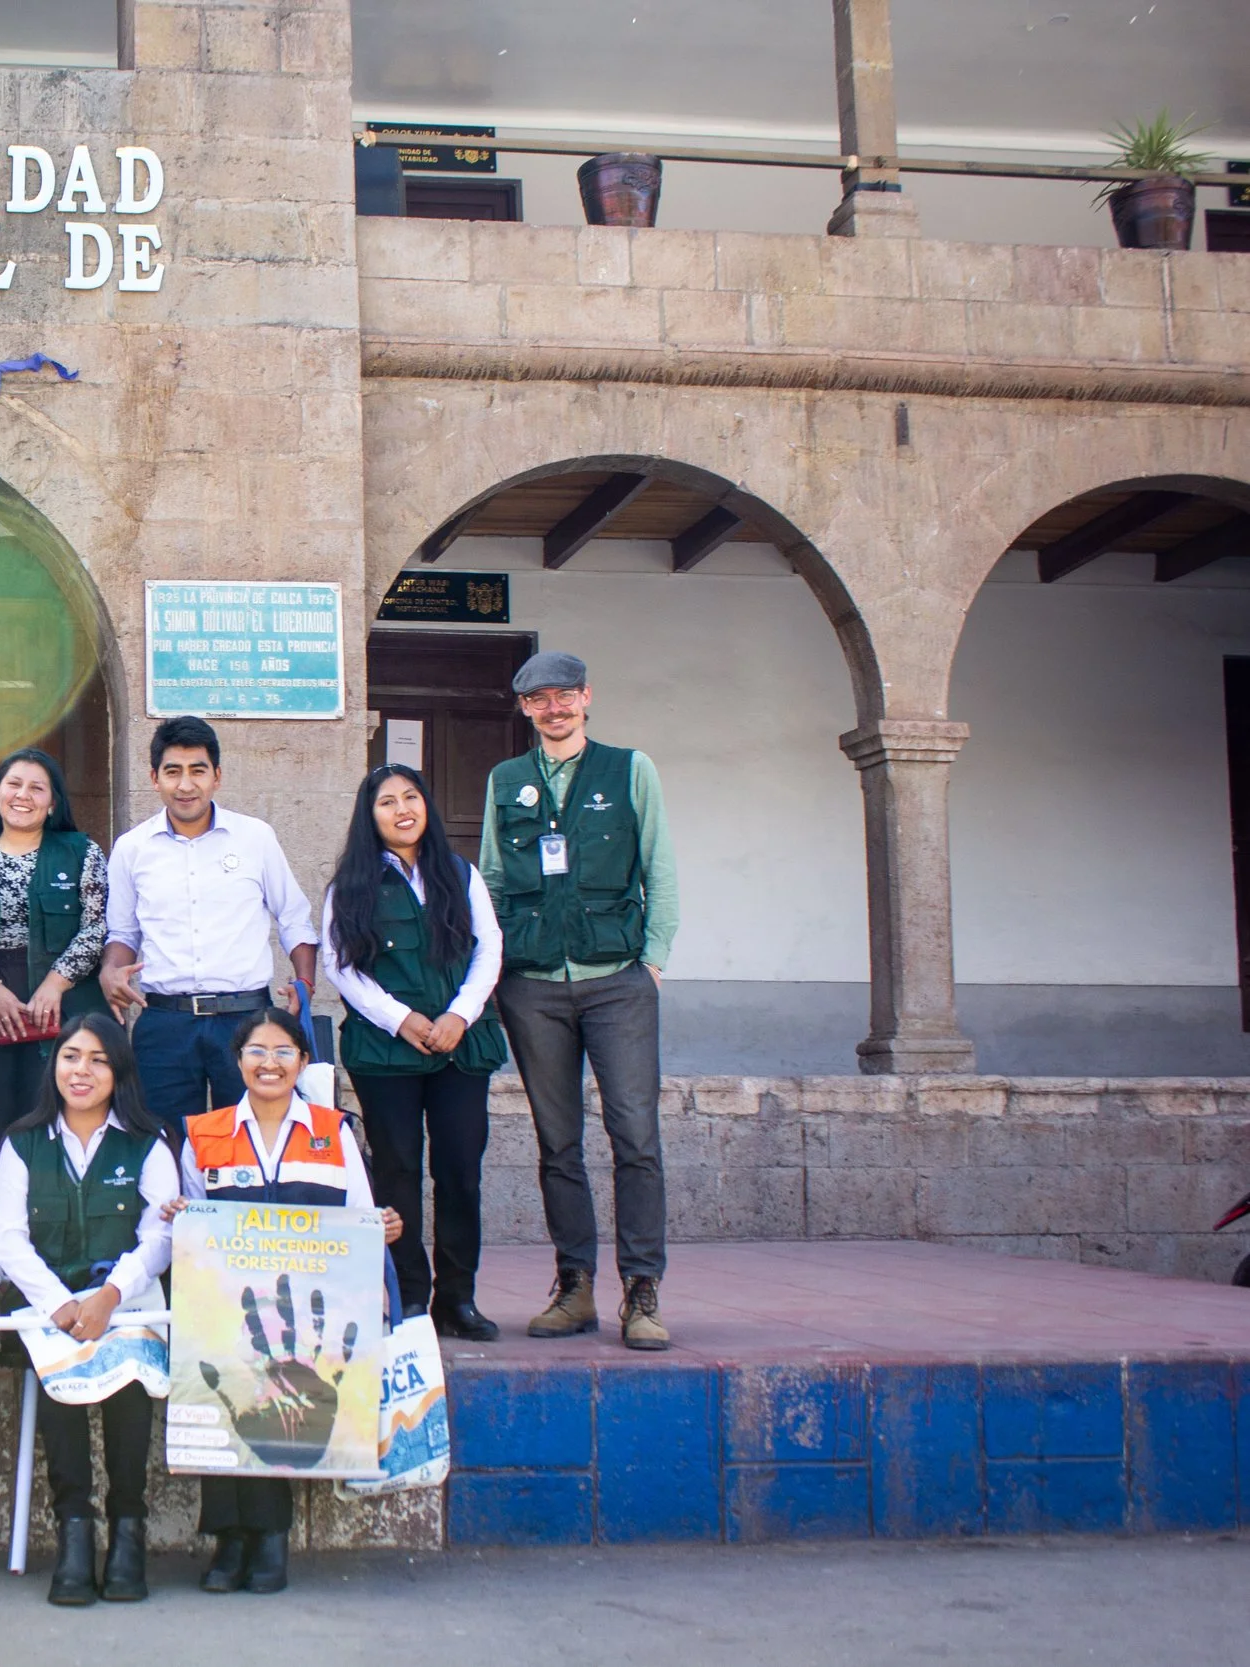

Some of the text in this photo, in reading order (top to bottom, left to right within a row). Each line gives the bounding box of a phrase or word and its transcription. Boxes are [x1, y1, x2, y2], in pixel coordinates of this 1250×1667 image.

[65, 221, 165, 292] DE
[154, 591, 334, 605] 1825 LA PROVINCIA DE CALCA 1975
[153, 609, 334, 633] A SIMON BOLIVAR EL LIBERTADOR
[153, 639, 337, 653] POR HABER CREADO ESTA PROVINCIA
[188, 656, 290, 672] HACE 150 AÑOS
[189, 1206, 218, 1214] CALCA
[236, 1208, 320, 1236] ¡ALTO!
[206, 1236, 350, 1257] A LOS INCENDIOS
[226, 1254, 328, 1274] FORESTALES
